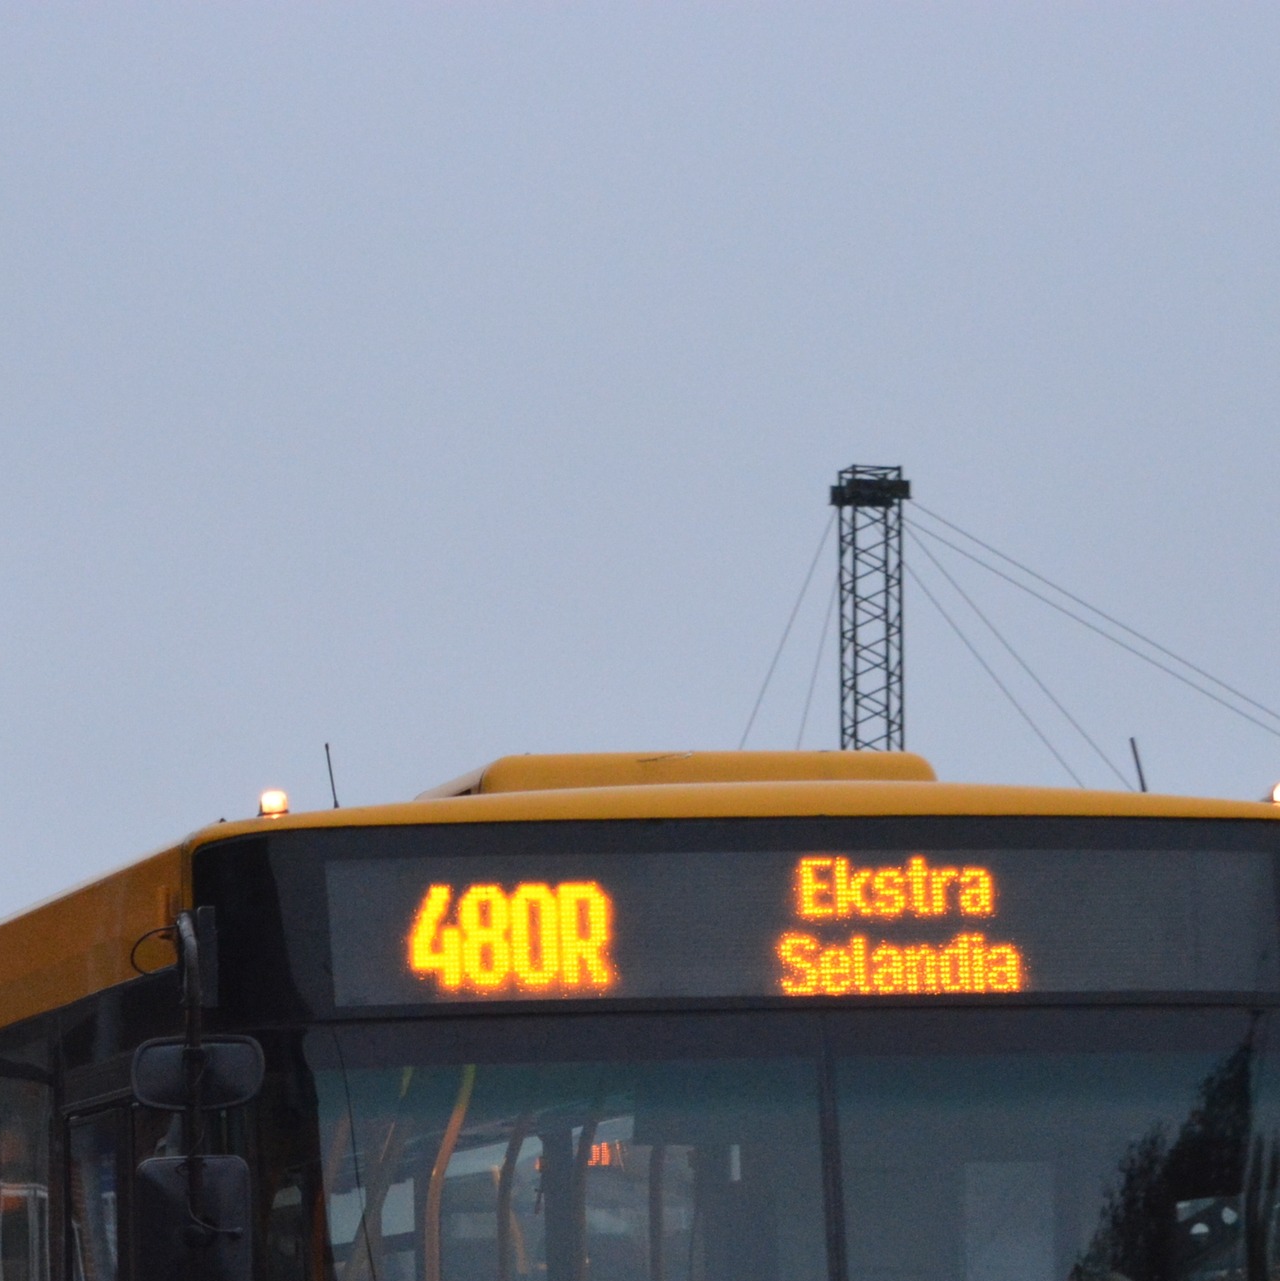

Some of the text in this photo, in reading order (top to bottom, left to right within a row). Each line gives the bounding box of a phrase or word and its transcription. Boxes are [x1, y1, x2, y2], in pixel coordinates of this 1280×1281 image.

[799, 857, 995, 917] Ekstra
[411, 883, 609, 986] 480R
[778, 933, 1022, 994] Selandia
